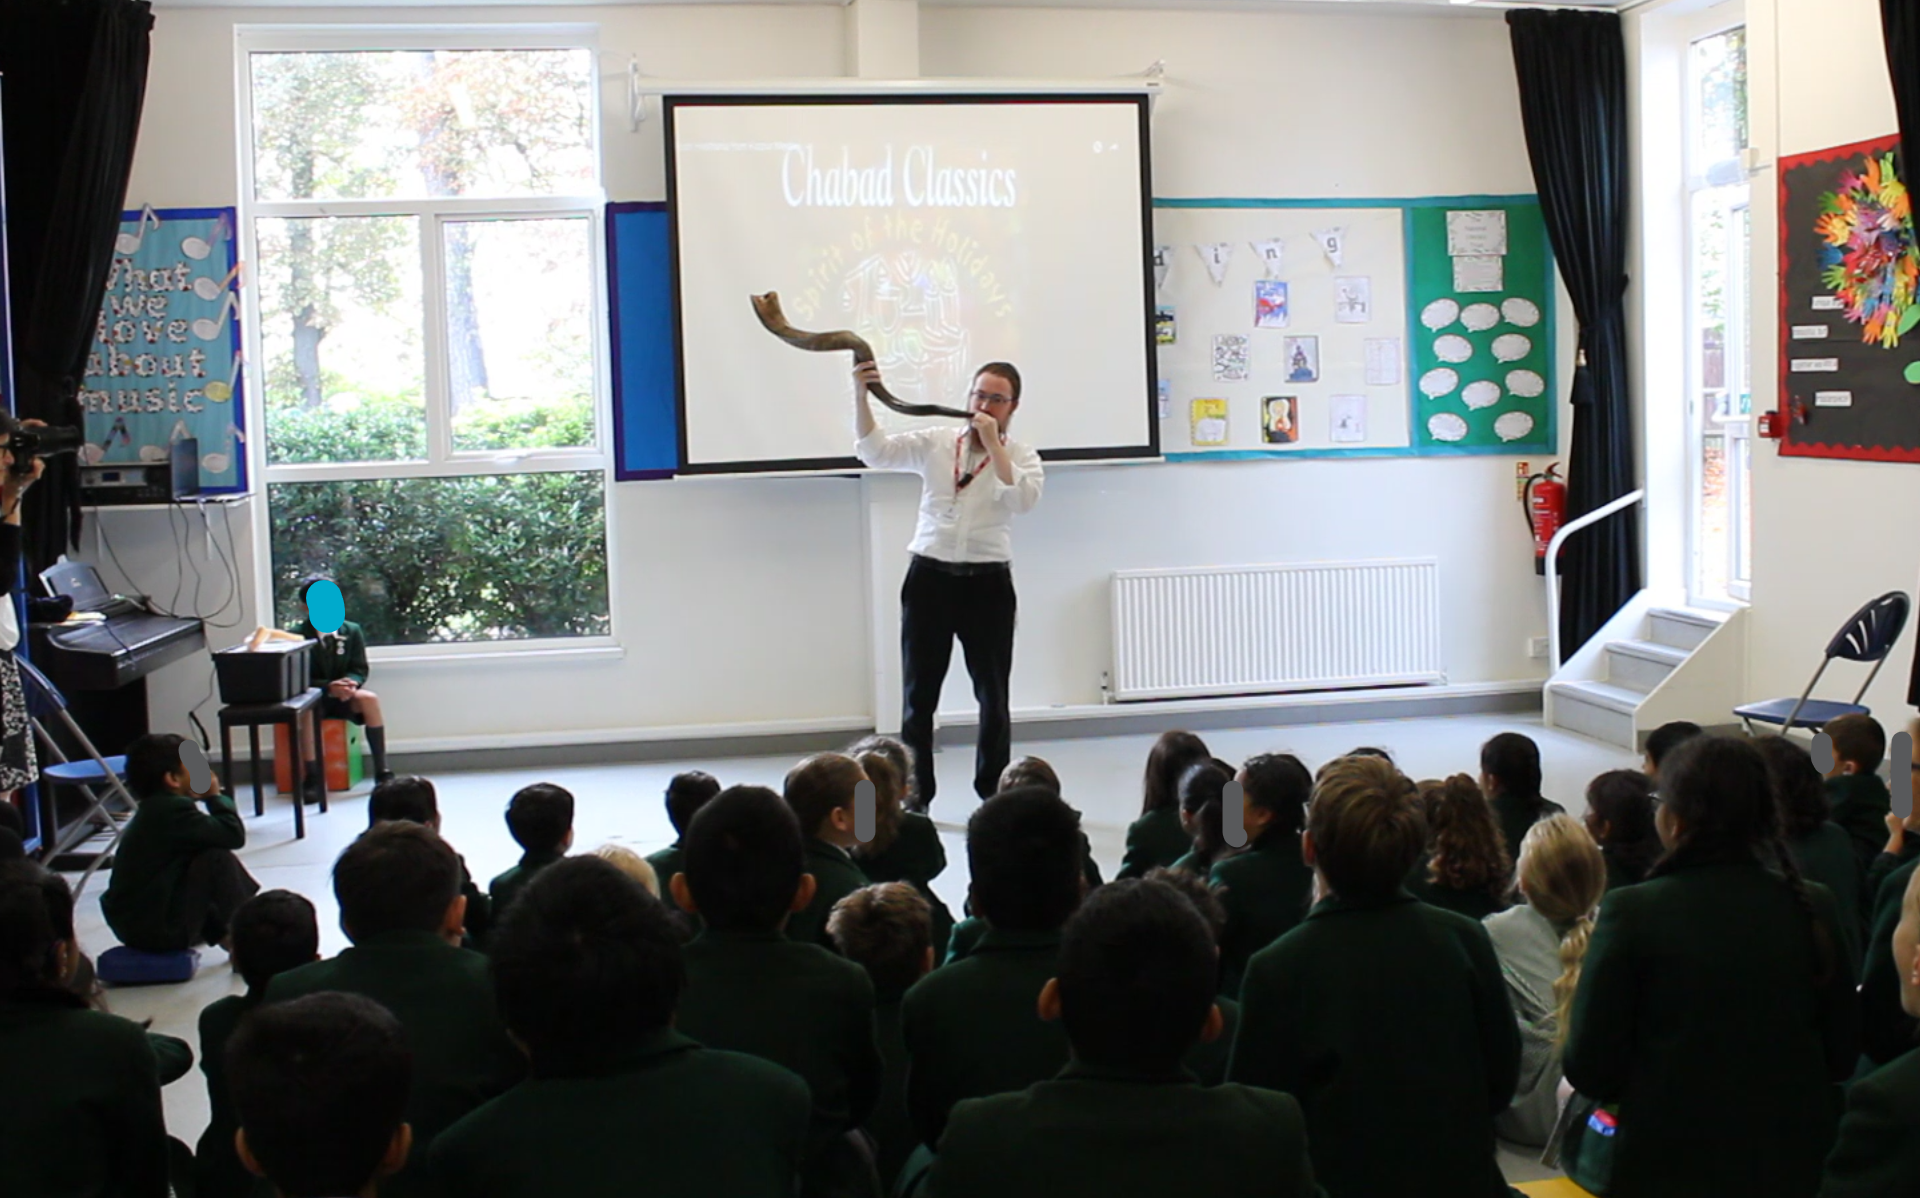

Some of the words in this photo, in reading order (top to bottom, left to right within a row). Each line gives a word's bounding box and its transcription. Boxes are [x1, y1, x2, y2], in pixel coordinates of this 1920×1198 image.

[781, 144, 895, 207] Chabad
[902, 144, 1016, 207] Classics
[791, 243, 845, 322] Spirit
[850, 214, 873, 251] of
[882, 210, 925, 243] the
[931, 215, 1013, 318] Holidays
[110, 294, 168, 318] we
[84, 341, 207, 378] about
[76, 380, 204, 414] music
